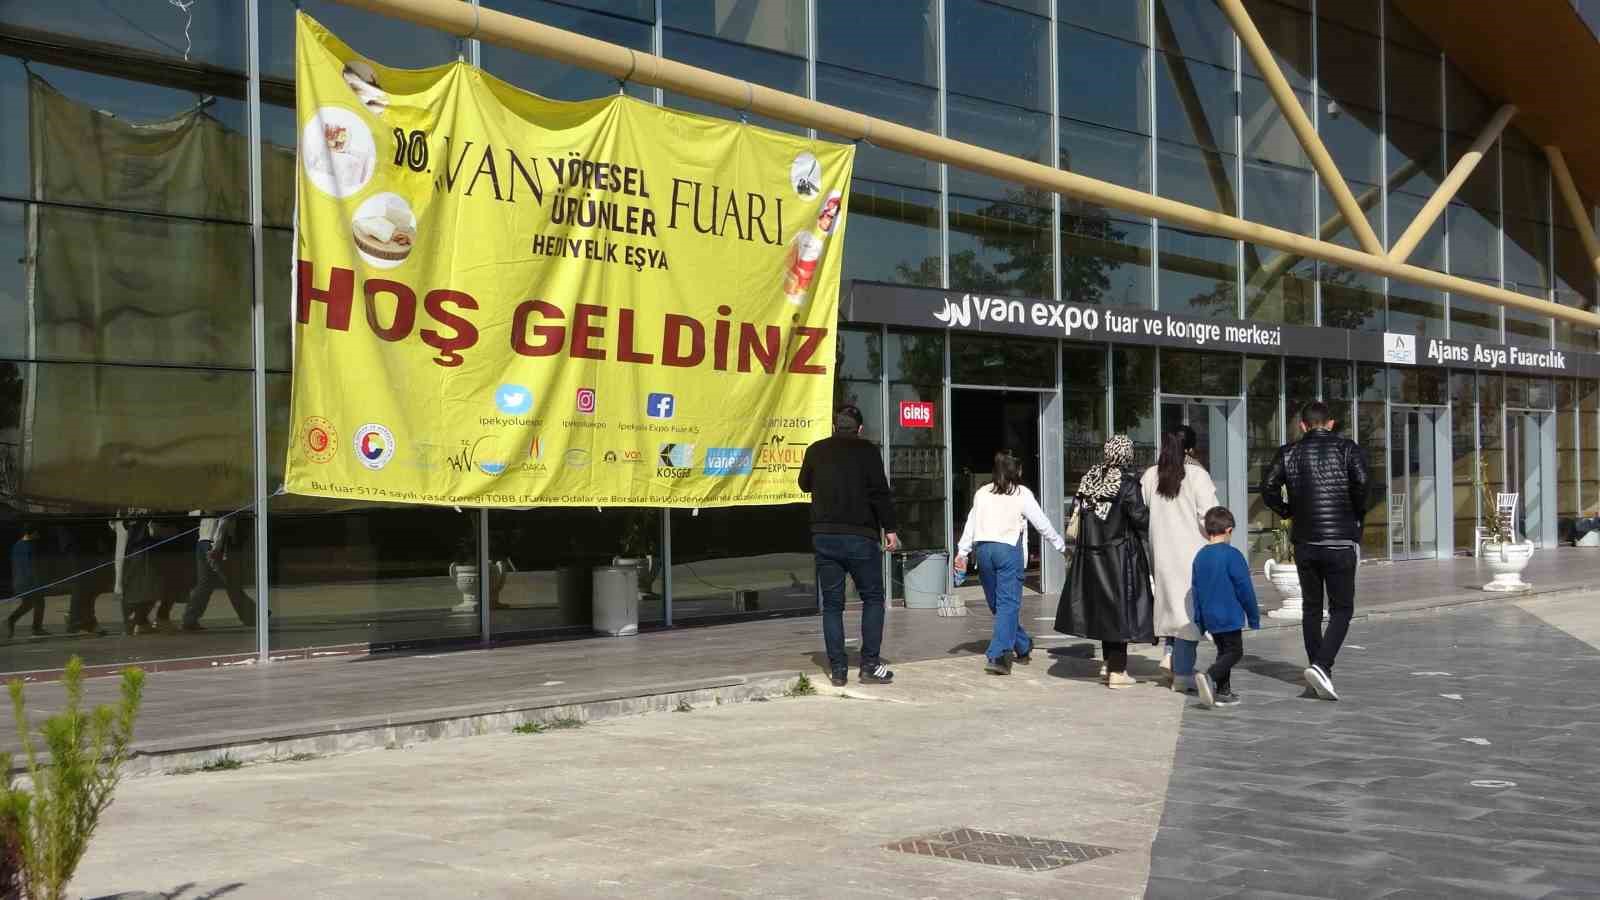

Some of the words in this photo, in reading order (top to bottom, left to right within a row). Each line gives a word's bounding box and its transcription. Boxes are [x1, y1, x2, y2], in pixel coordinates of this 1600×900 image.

[393, 127, 431, 172] 10.
[444, 135, 543, 207] VAN
[547, 152, 650, 199] YÖRESEL
[551, 187, 657, 238] ÜRÜNLER
[667, 178, 784, 246] FUARI
[624, 245, 669, 272] EŞYA
[297, 259, 480, 368] HOŞ
[972, 296, 1025, 324] van
[1031, 302, 1099, 336] expo
[1105, 310, 1139, 334] fuar
[1143, 318, 1163, 336] ve
[1166, 316, 1221, 345] kongre
[1225, 325, 1281, 346] merkezi
[1428, 339, 1469, 364] Ajans
[1473, 343, 1507, 368] Asya
[1510, 347, 1566, 369] Fuarcılık
[903, 403, 930, 424] GİRİŞ
[311, 481, 327, 491] Bu
[330, 483, 353, 493] fuar
[357, 486, 386, 496] 5174
[767, 463, 787, 473] EXPO
